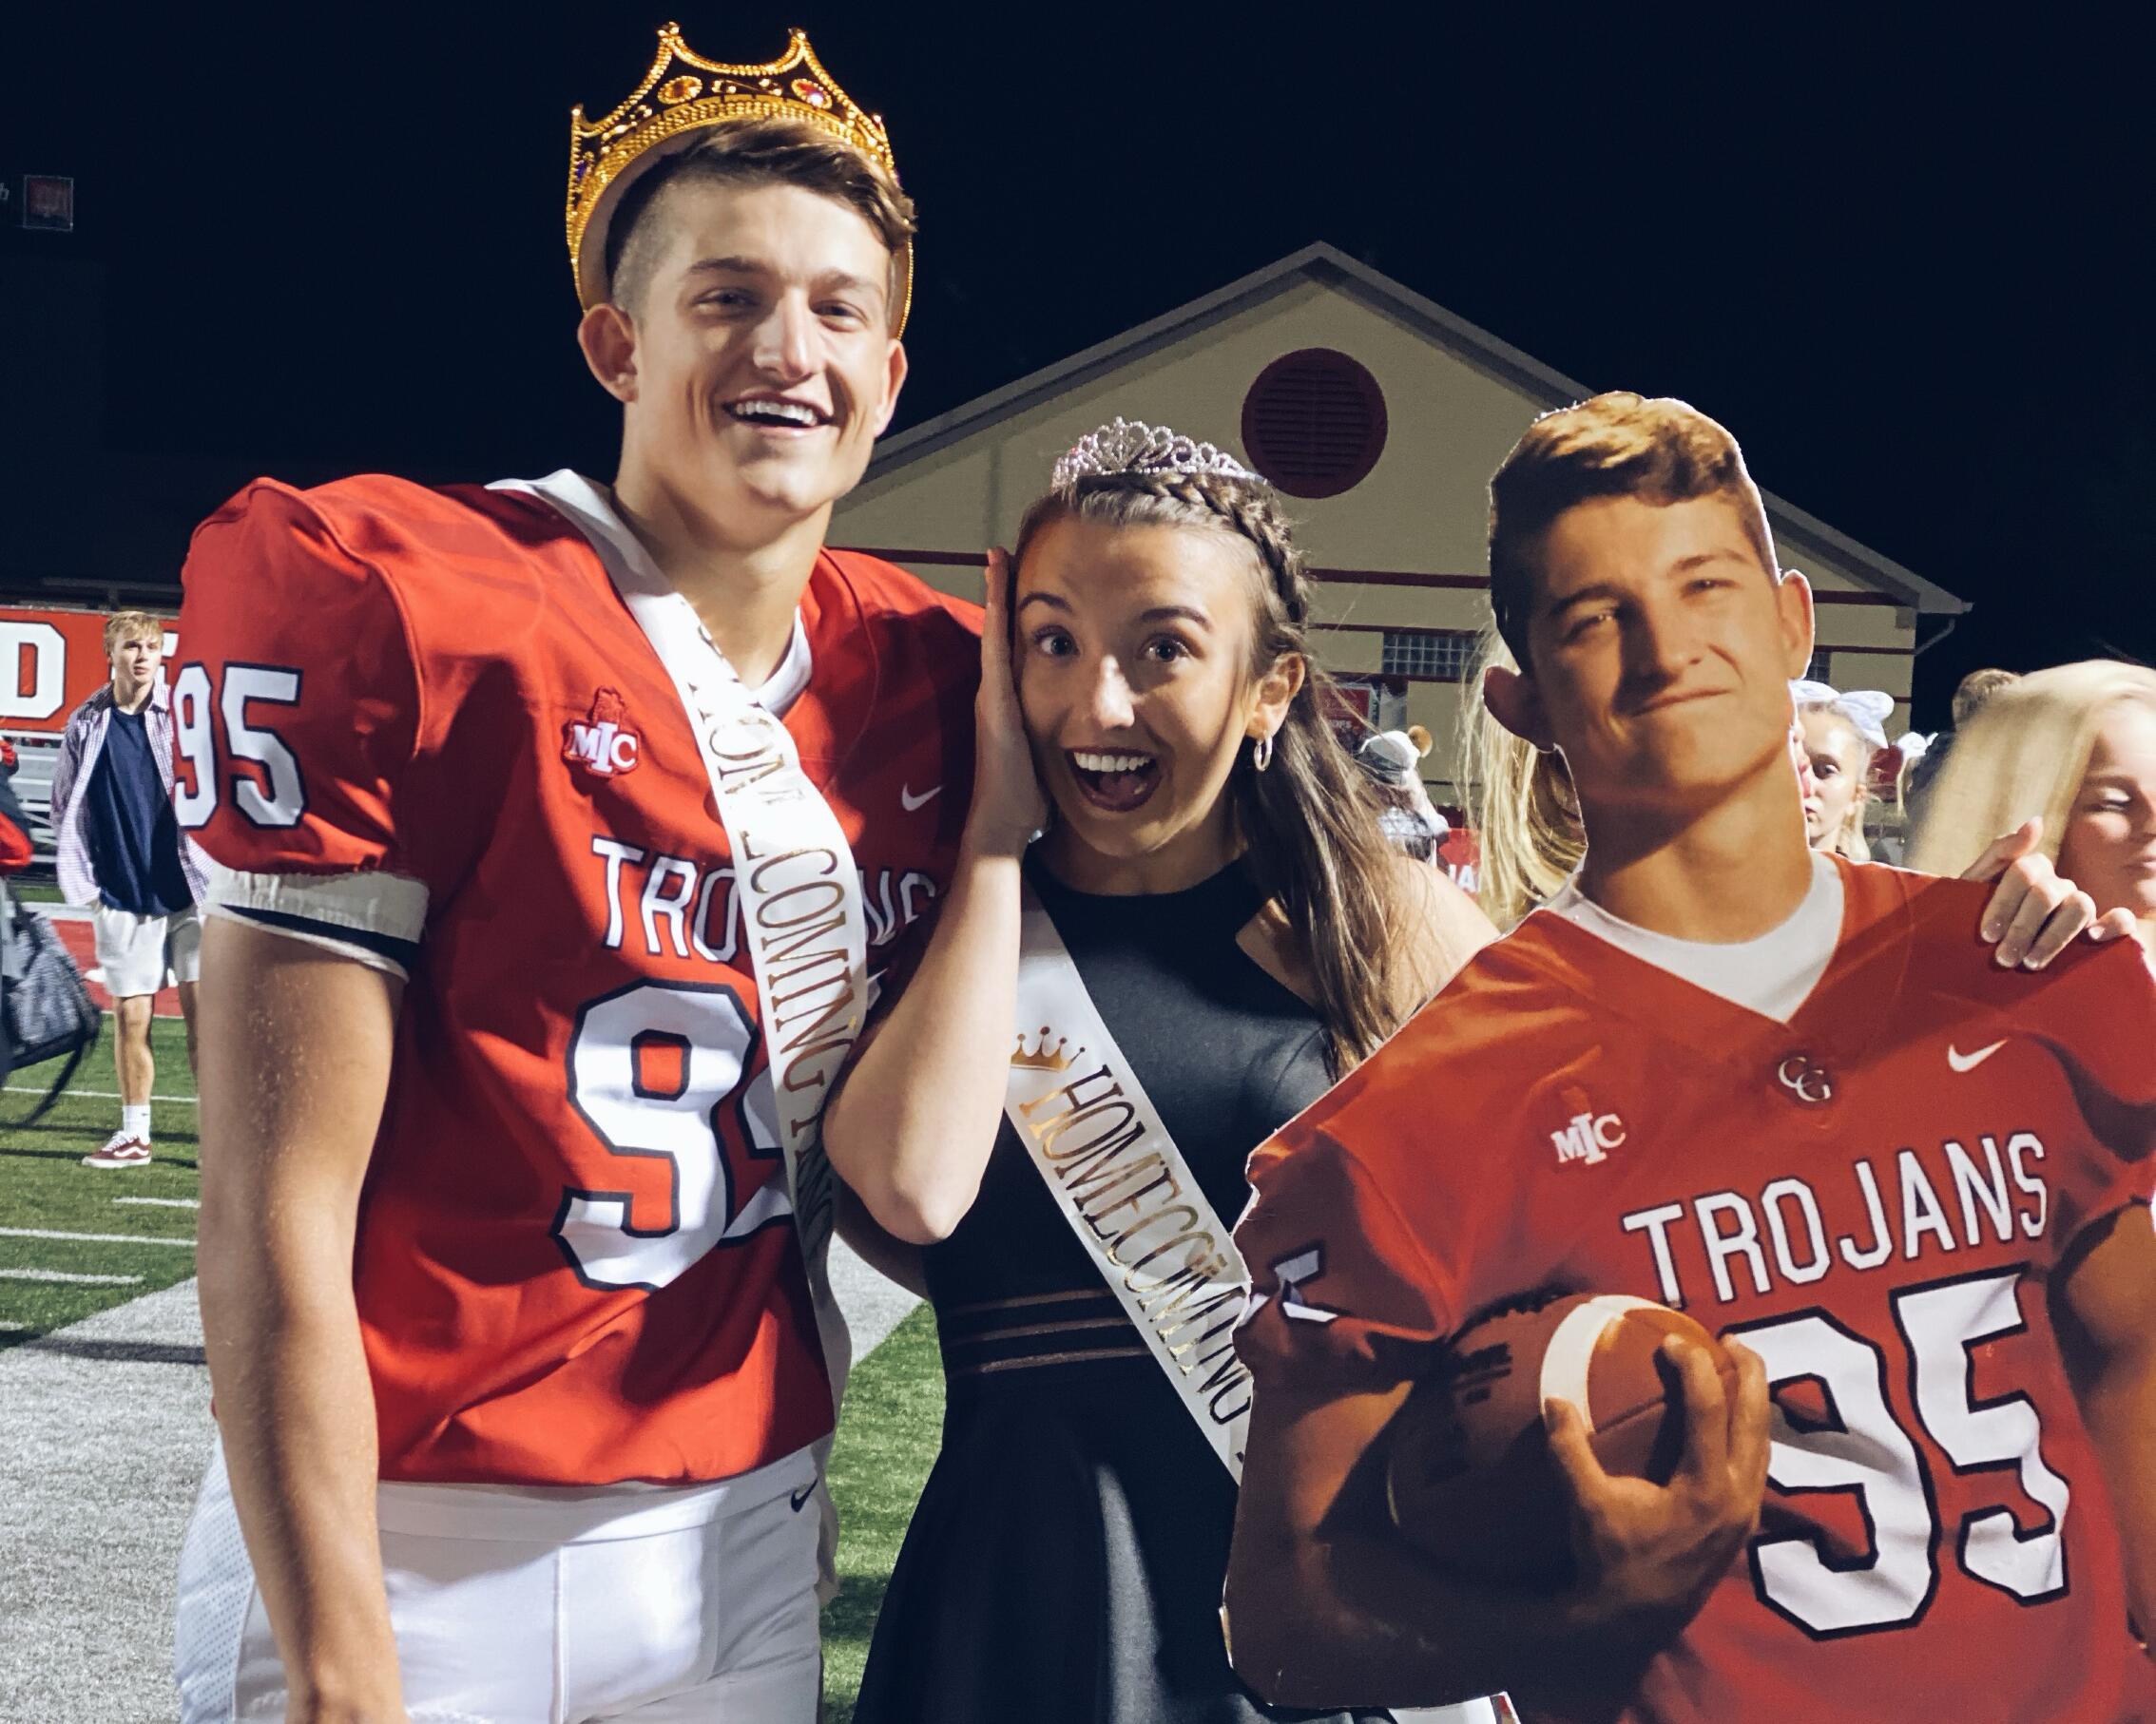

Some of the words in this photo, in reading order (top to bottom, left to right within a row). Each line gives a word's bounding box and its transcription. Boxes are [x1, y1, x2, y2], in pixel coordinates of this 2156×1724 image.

[171, 661, 307, 829] 95
[590, 835, 936, 963] TRONS
[1018, 1063, 1252, 1426] HOMECOMING
[1620, 1132, 2050, 1308] TROJANS
[1721, 1262, 2070, 1640] 95
